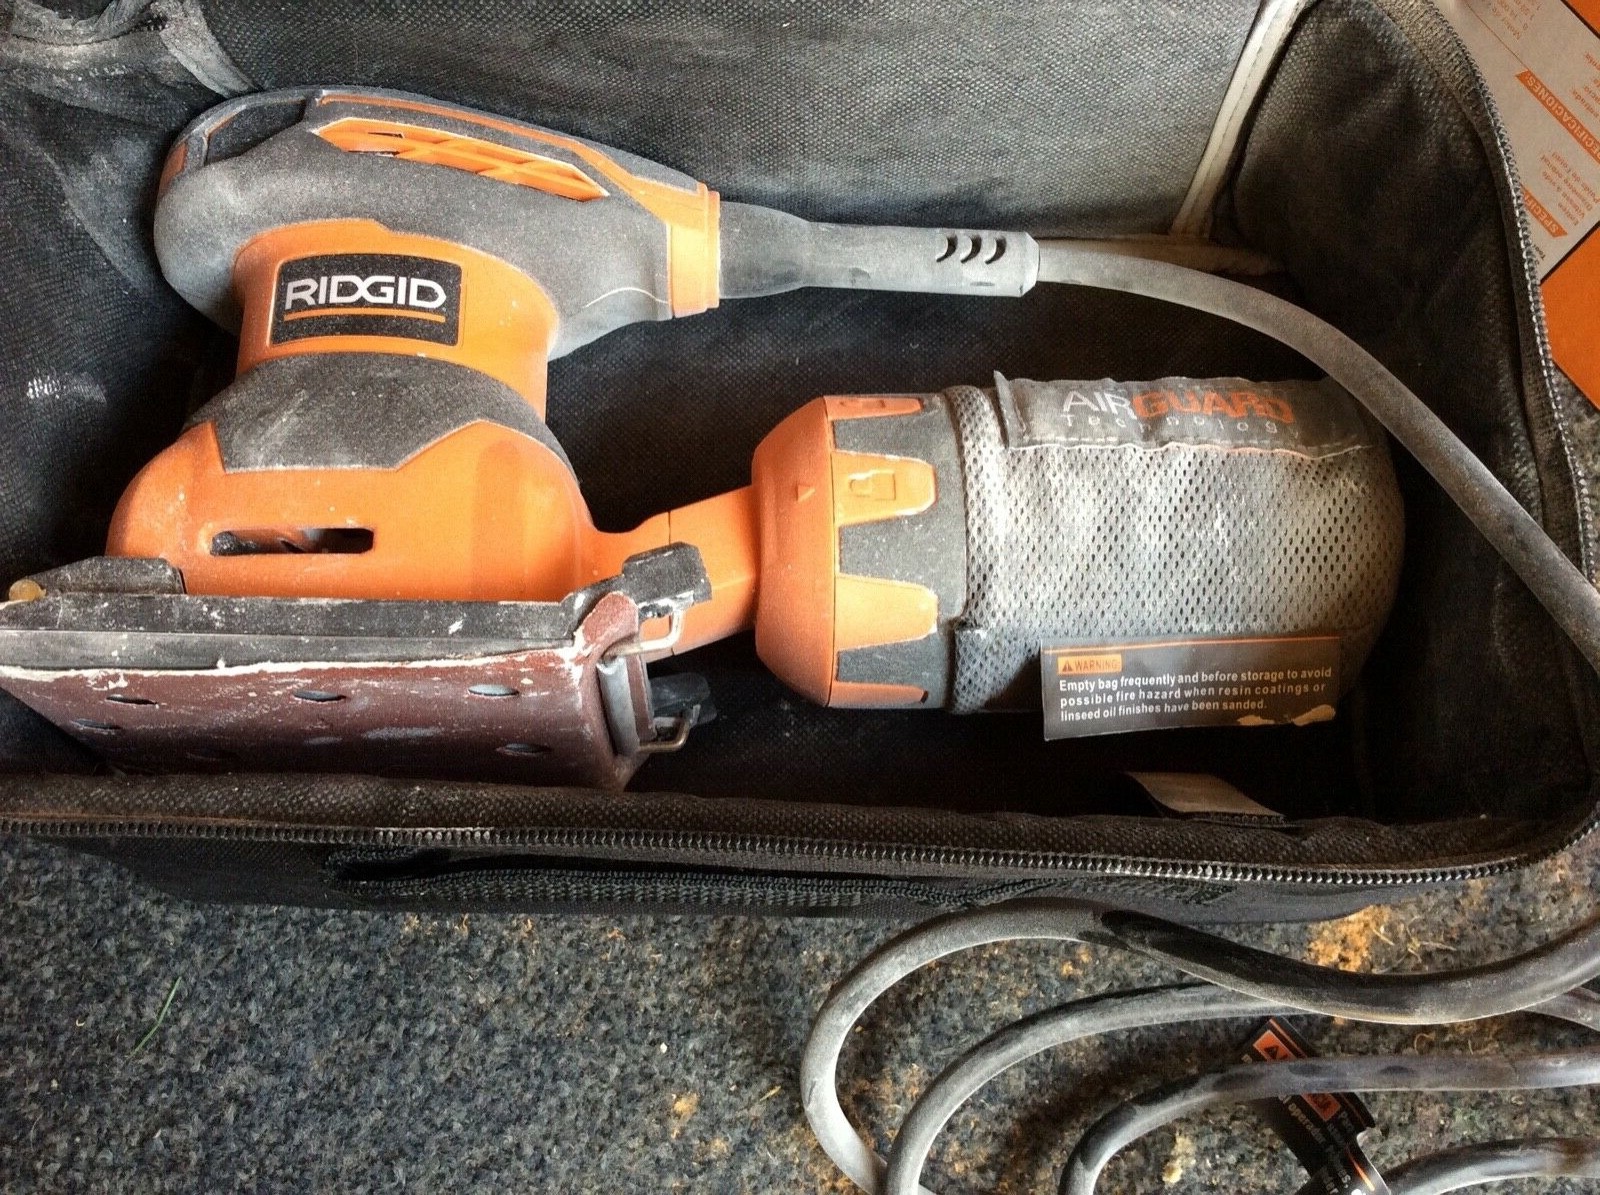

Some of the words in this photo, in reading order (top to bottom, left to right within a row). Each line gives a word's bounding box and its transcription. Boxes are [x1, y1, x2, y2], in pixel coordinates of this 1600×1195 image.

[284, 274, 447, 310] RIDGID
[1075, 659, 1119, 671] WARNING
[1060, 679, 1096, 692] Empty
[1098, 678, 1118, 691] bag
[1120, 673, 1176, 688] frequently
[1178, 672, 1199, 684] and
[1201, 671, 1238, 682] before
[1241, 670, 1284, 682] storage
[1287, 669, 1298, 679] to
[1301, 667, 1332, 678] avoid
[1060, 694, 1113, 709] possible
[1116, 691, 1136, 701] fire
[1139, 689, 1180, 700] hazard
[1184, 687, 1215, 698] when
[1218, 685, 1251, 696] resin
[1255, 684, 1309, 696] coatings
[1313, 684, 1326, 692] or
[1060, 709, 1101, 722] linseed
[1103, 707, 1116, 718] oil
[1118, 704, 1161, 717] finishes
[1164, 703, 1189, 713] have
[1191, 700, 1219, 711] been
[1222, 700, 1267, 711] sanded.
